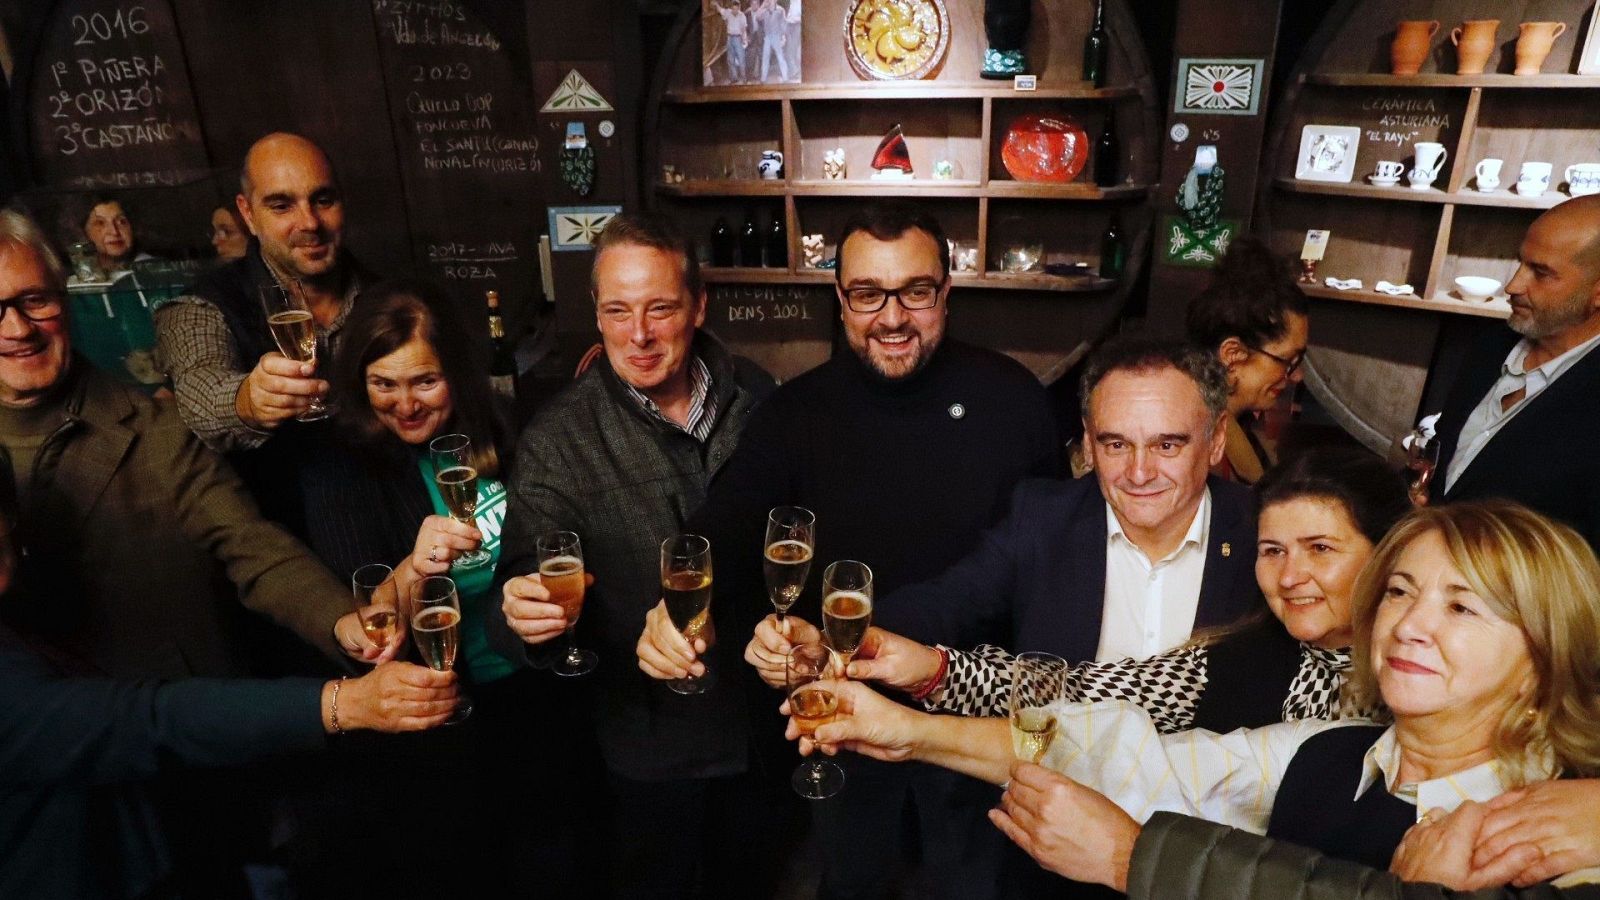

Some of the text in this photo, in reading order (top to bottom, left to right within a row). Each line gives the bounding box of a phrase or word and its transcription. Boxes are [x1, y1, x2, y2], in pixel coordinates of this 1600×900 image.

[72, 6, 150, 45] 2016
[77, 55, 166, 86] PIÑERA
[408, 62, 472, 83] 2023
[1379, 114, 1450, 129] ASTURIANA
[444, 266, 497, 280] ROZA
